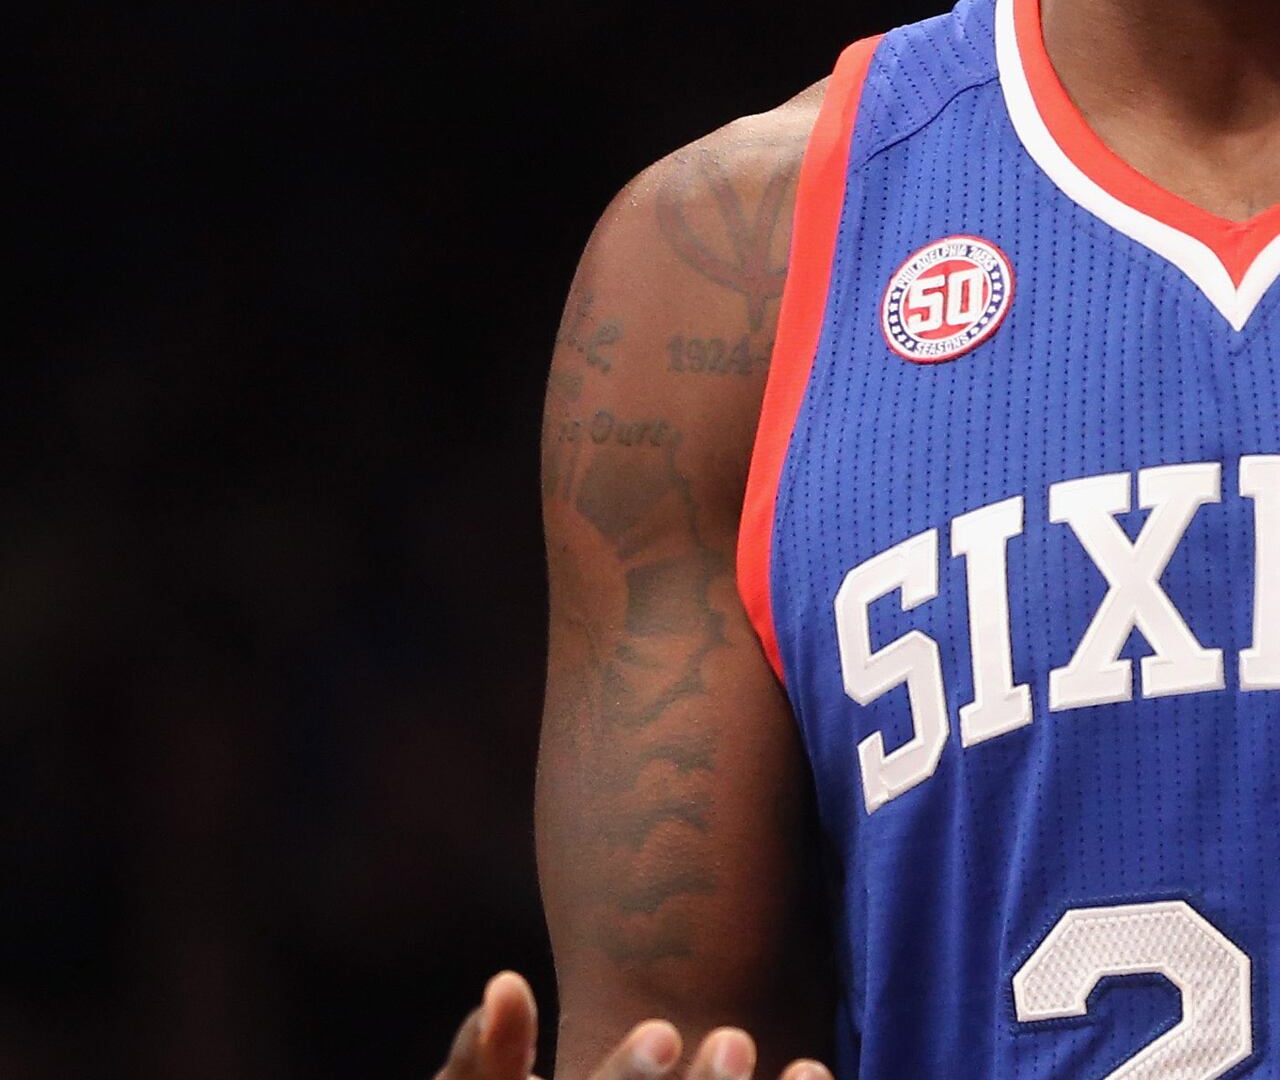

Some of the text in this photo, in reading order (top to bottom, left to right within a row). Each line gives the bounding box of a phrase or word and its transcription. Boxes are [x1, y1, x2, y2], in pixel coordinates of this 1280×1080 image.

[896, 244, 967, 288] PHILADELPHIA
[908, 268, 984, 333] 50
[915, 334, 970, 355] SEASONS
